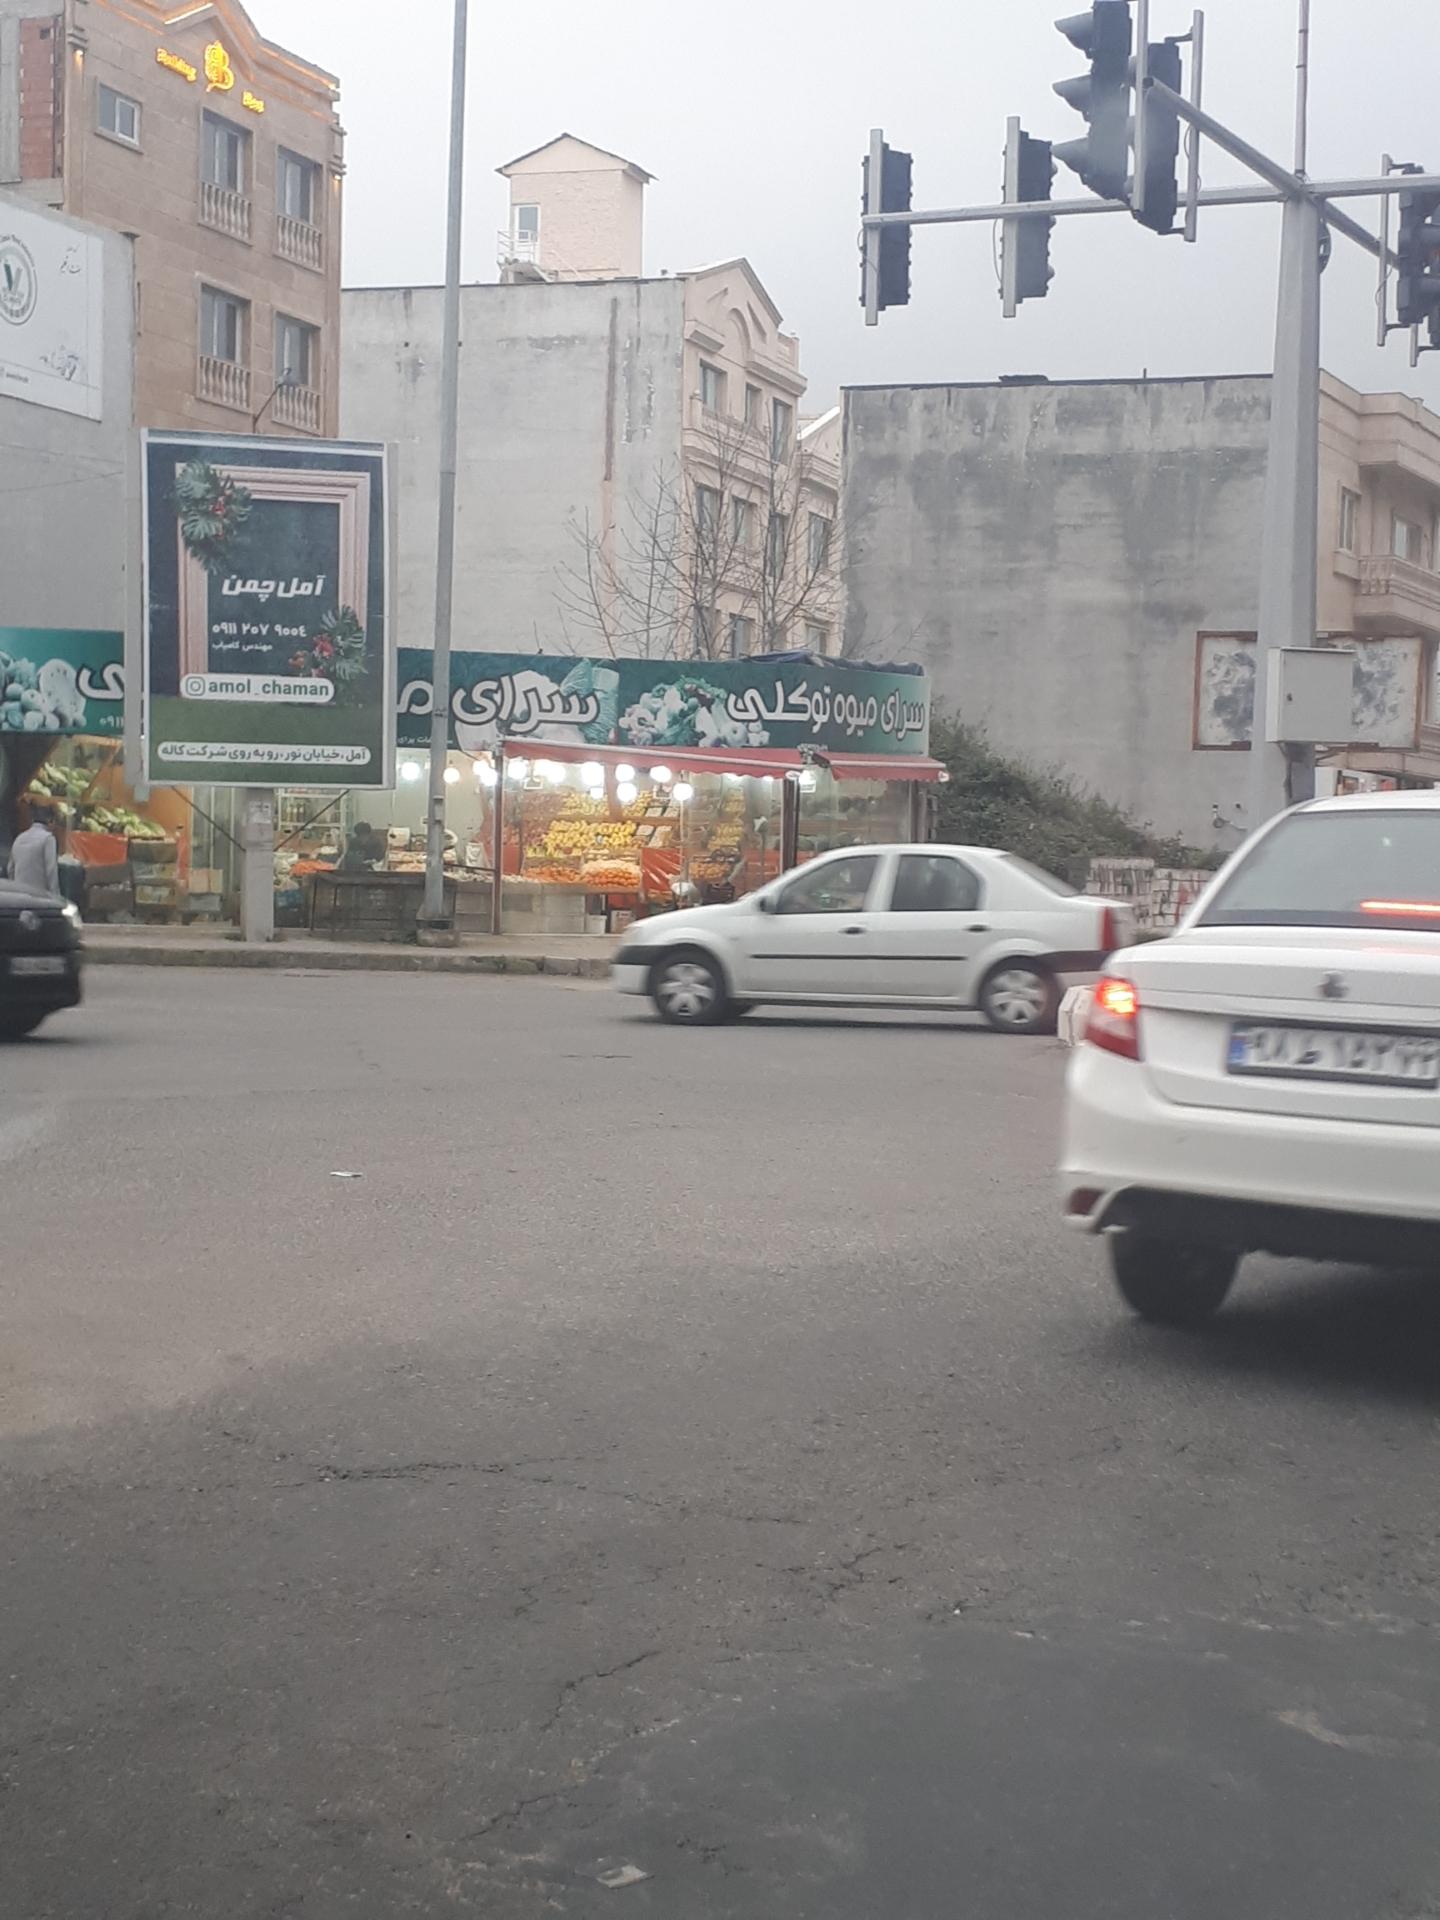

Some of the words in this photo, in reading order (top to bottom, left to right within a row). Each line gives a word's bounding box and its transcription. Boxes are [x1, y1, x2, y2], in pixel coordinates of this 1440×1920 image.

[222, 575, 276, 602] چمن
[277, 574, 326, 598] آمل
[208, 679, 329, 696] amol_chaman
[451, 675, 599, 733] سرای
[727, 680, 831, 733] توکلی
[834, 693, 878, 737] میوه
[881, 690, 926, 740] سرای
[161, 744, 185, 755] کاله
[186, 745, 227, 759] شرکت
[302, 748, 340, 762] خیابان
